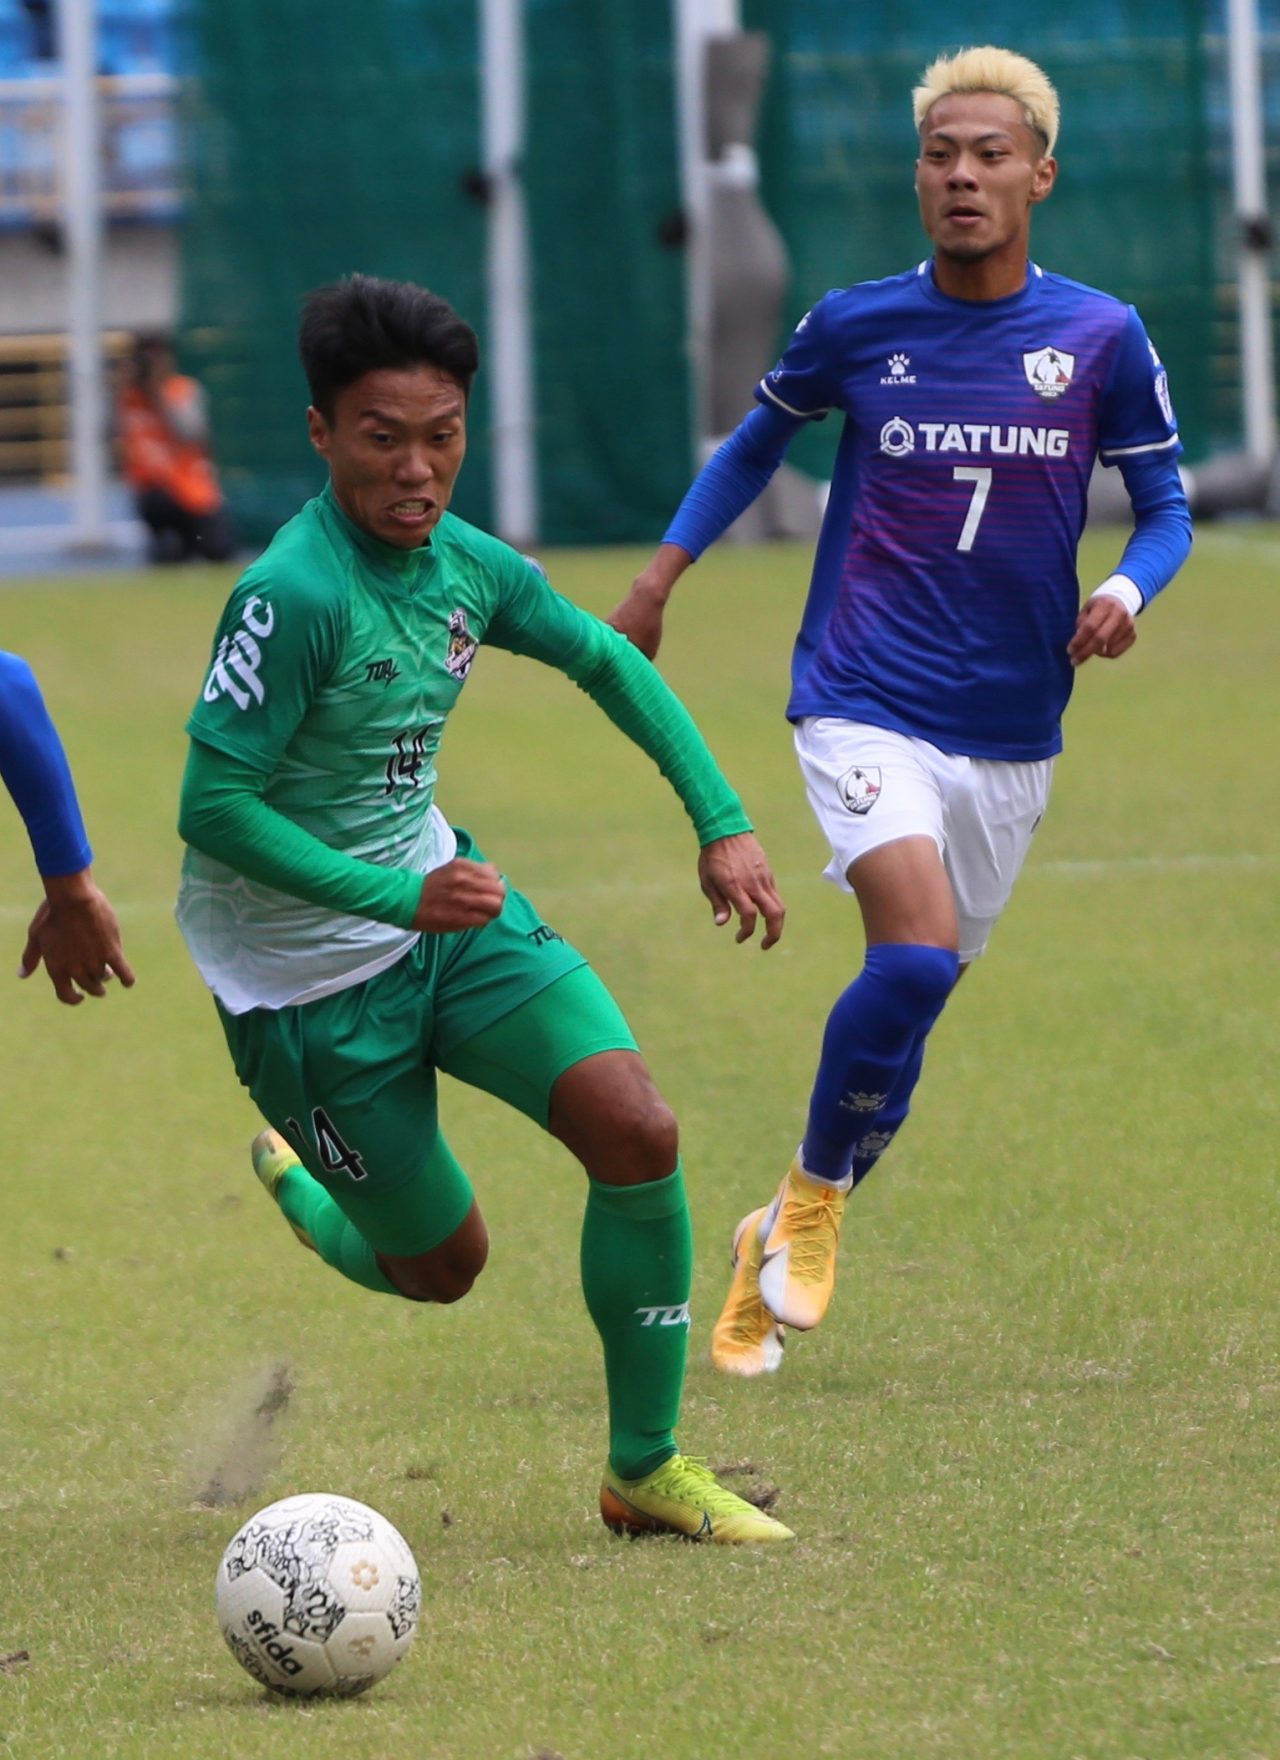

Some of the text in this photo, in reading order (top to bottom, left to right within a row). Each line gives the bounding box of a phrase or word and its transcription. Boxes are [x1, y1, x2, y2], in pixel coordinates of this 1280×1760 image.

[879, 375, 917, 385] KELME
[918, 423, 1070, 457] TATUNG
[952, 466, 993, 551] 7
[384, 723, 434, 796] 14
[247, 1609, 304, 1676] sfida
